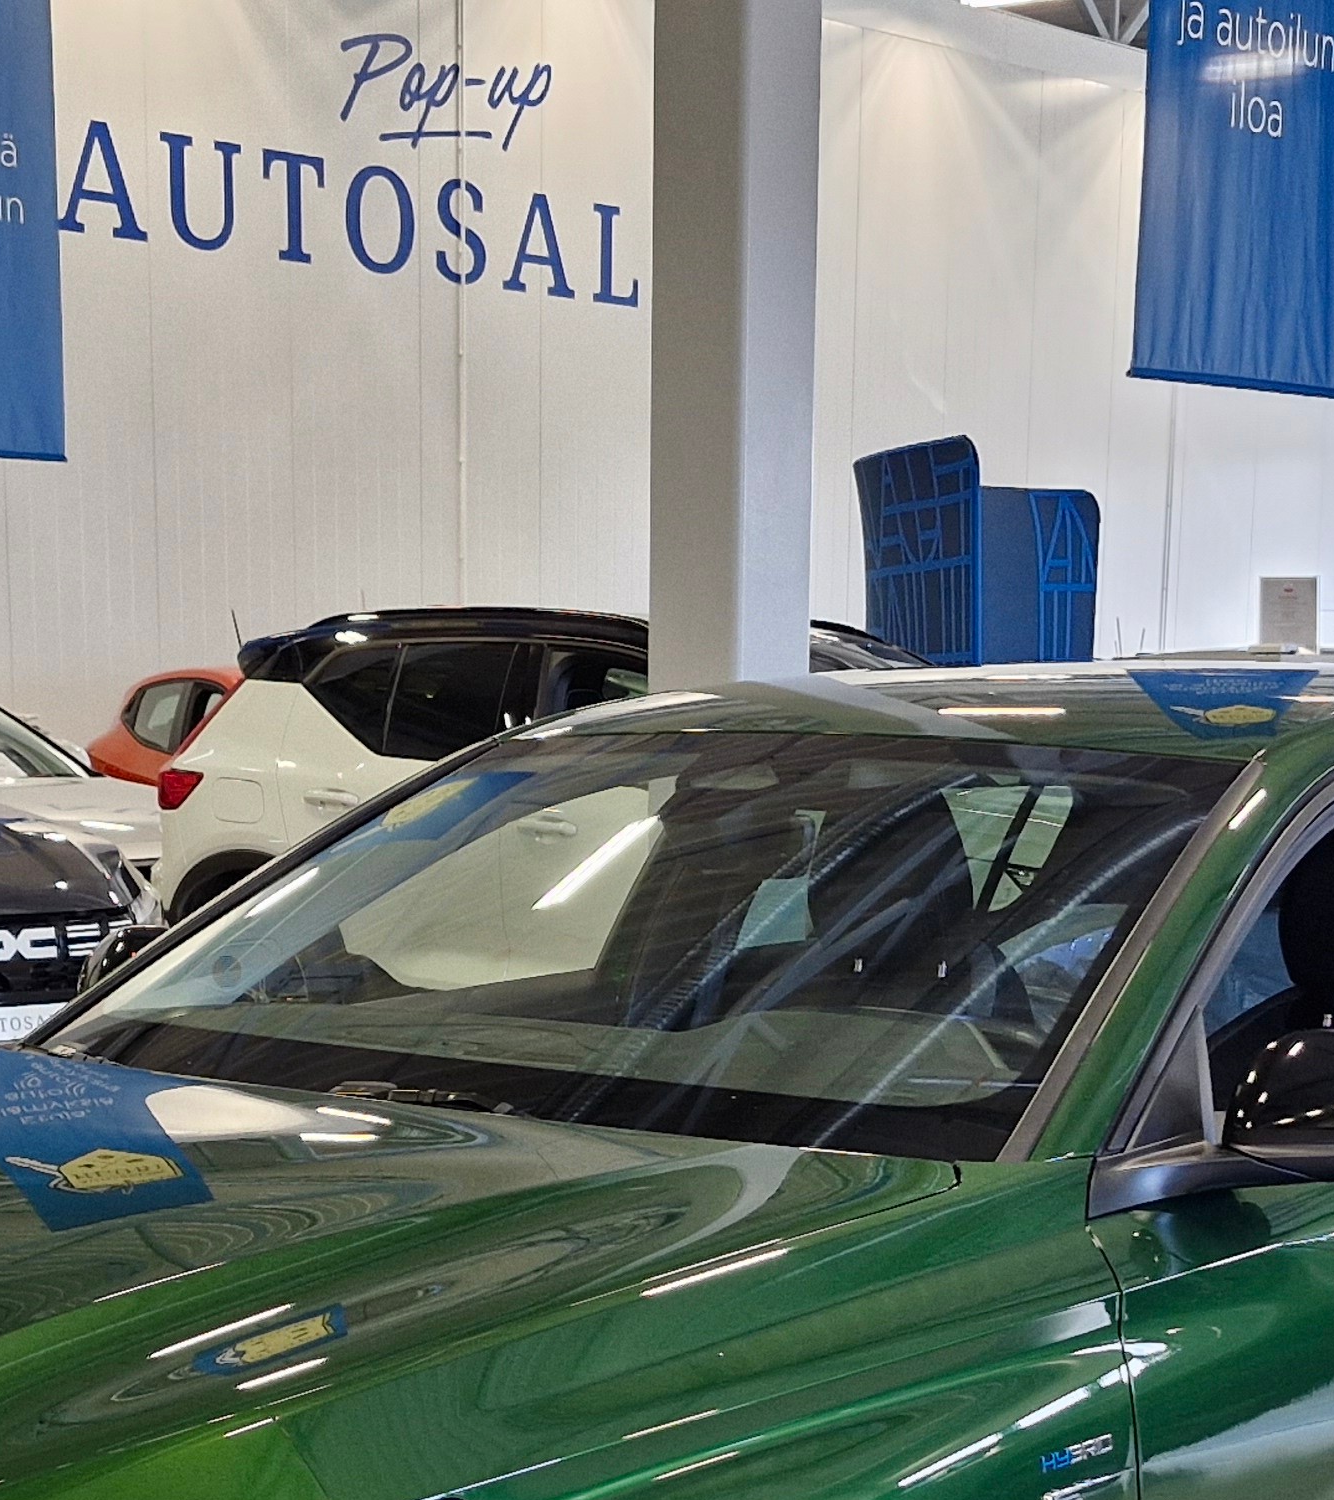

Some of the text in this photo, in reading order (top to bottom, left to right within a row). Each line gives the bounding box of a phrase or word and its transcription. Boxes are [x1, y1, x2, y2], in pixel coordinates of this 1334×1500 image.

[1216, 7, 1334, 72] autoilun
[340, 32, 553, 152] Pop-up
[1230, 79, 1283, 138] iloa
[57, 119, 640, 308] AUTOSAL
